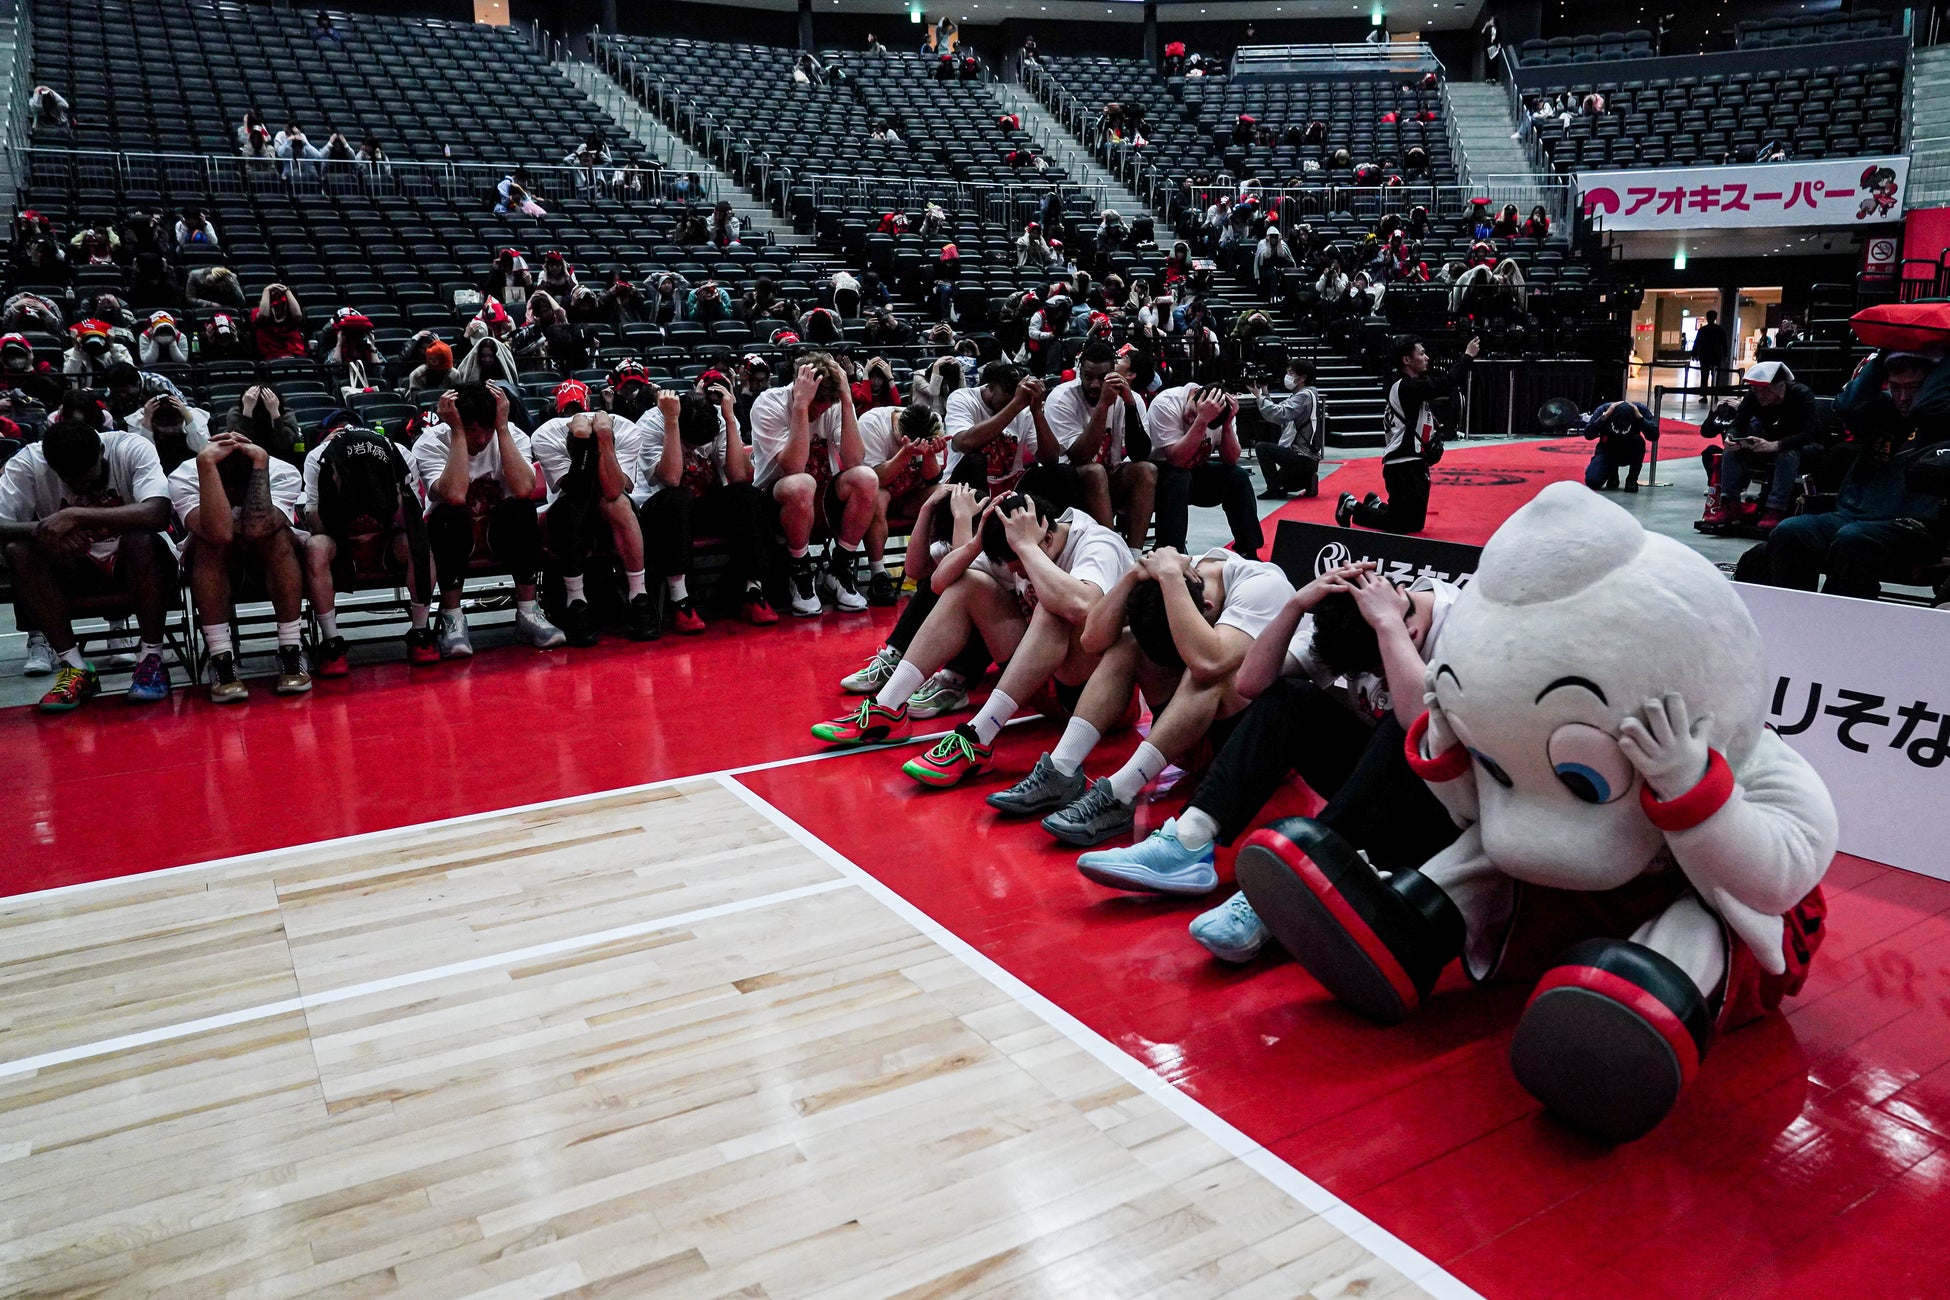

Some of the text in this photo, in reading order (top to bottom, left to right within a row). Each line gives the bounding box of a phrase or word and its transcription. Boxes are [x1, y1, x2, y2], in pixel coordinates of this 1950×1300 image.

[1625, 180, 1855, 216] アオキスーパー
[1771, 676, 1950, 768] りそな
